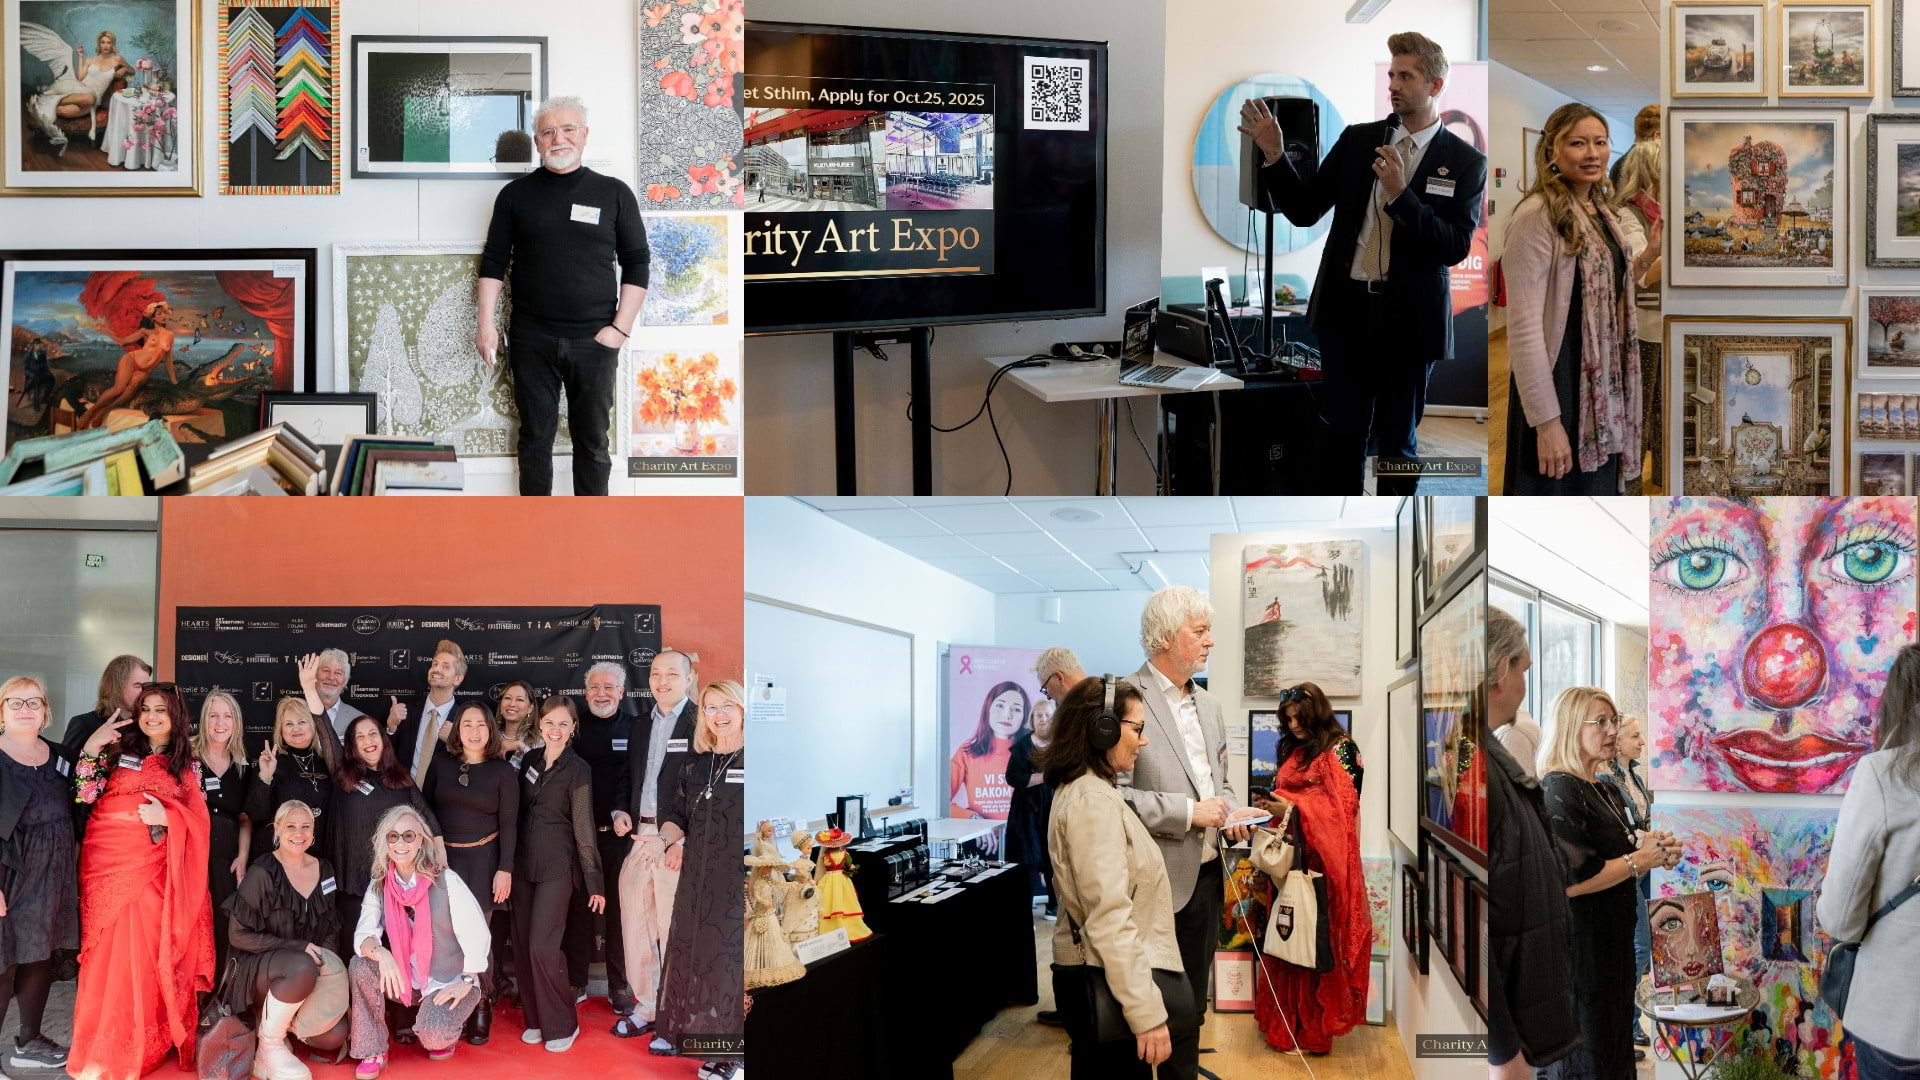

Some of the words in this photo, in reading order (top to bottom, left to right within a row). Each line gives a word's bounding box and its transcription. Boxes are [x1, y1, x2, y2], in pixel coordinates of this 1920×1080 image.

[744, 88, 759, 100] et
[763, 87, 815, 102] Sthlm,
[818, 88, 863, 105] Apply
[867, 89, 890, 103] for
[893, 90, 945, 106] Oct.25,
[948, 93, 985, 106] 2025
[744, 220, 812, 267] rity
[814, 218, 881, 254] Art
[889, 218, 980, 262] Expo
[1458, 256, 1483, 270] DIG
[984, 773, 995, 785] VI
[975, 786, 1011, 798] BAKOM
